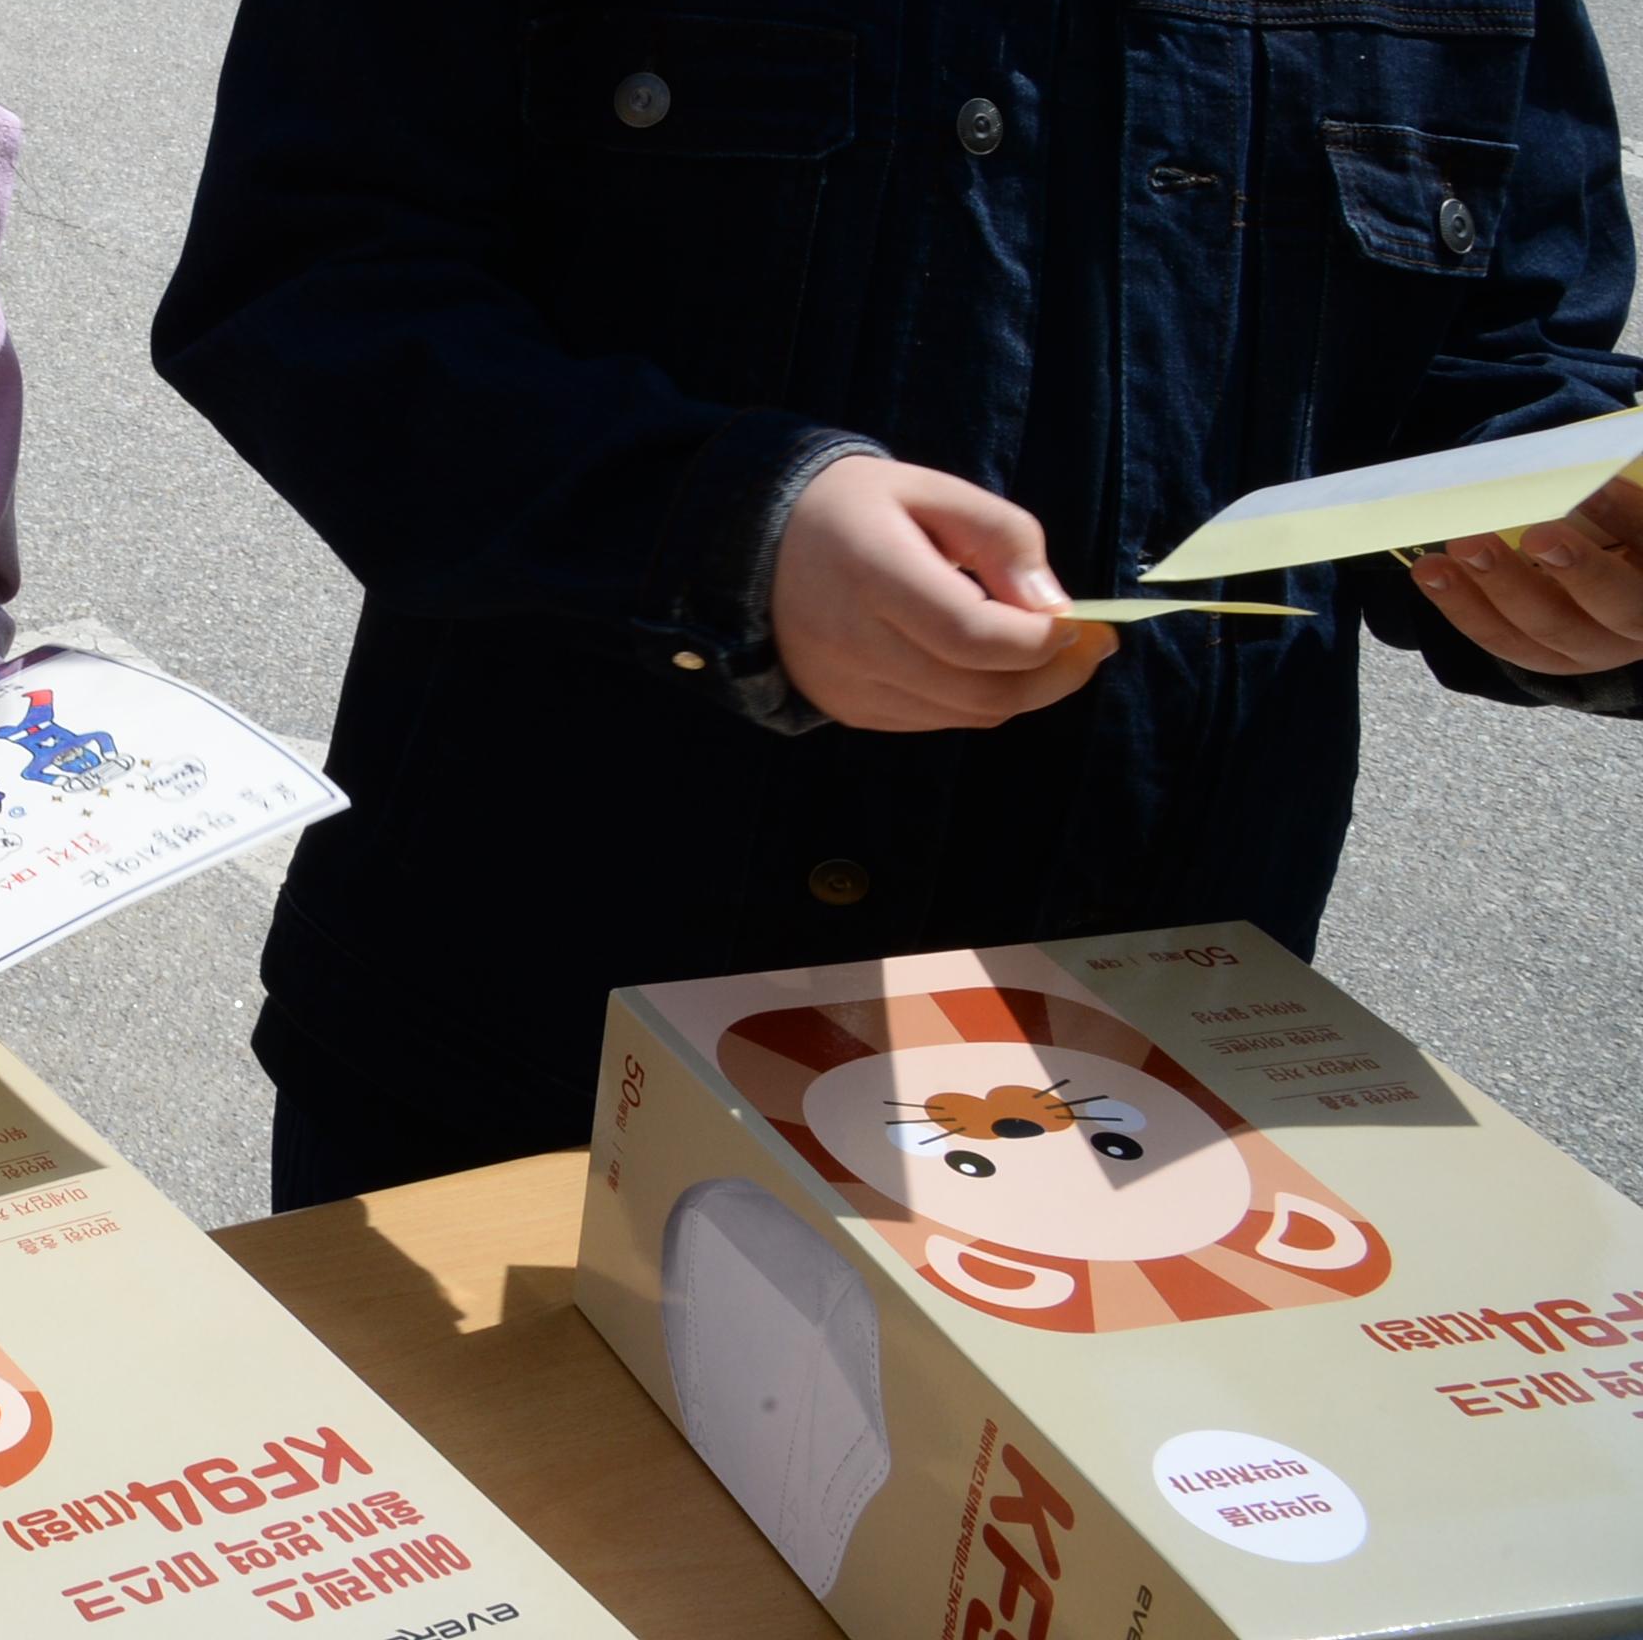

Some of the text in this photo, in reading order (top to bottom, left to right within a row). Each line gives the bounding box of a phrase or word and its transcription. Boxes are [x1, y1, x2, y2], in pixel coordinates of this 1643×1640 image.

[2, 1157, 59, 1180] 편안한
[13, 1187, 89, 1219] 미세입자
[17, 1217, 120, 1255] 편안한 호흡
[1435, 1371, 1596, 1417] 마스크
[2, 1426, 374, 1552] KF94(대형)
[1167, 1455, 1312, 1497] 식약처허가
[1218, 1492, 1334, 1530] 의약외품
[61, 1550, 220, 1623] 마스크
[252, 1533, 472, 1623] 에버렉스
